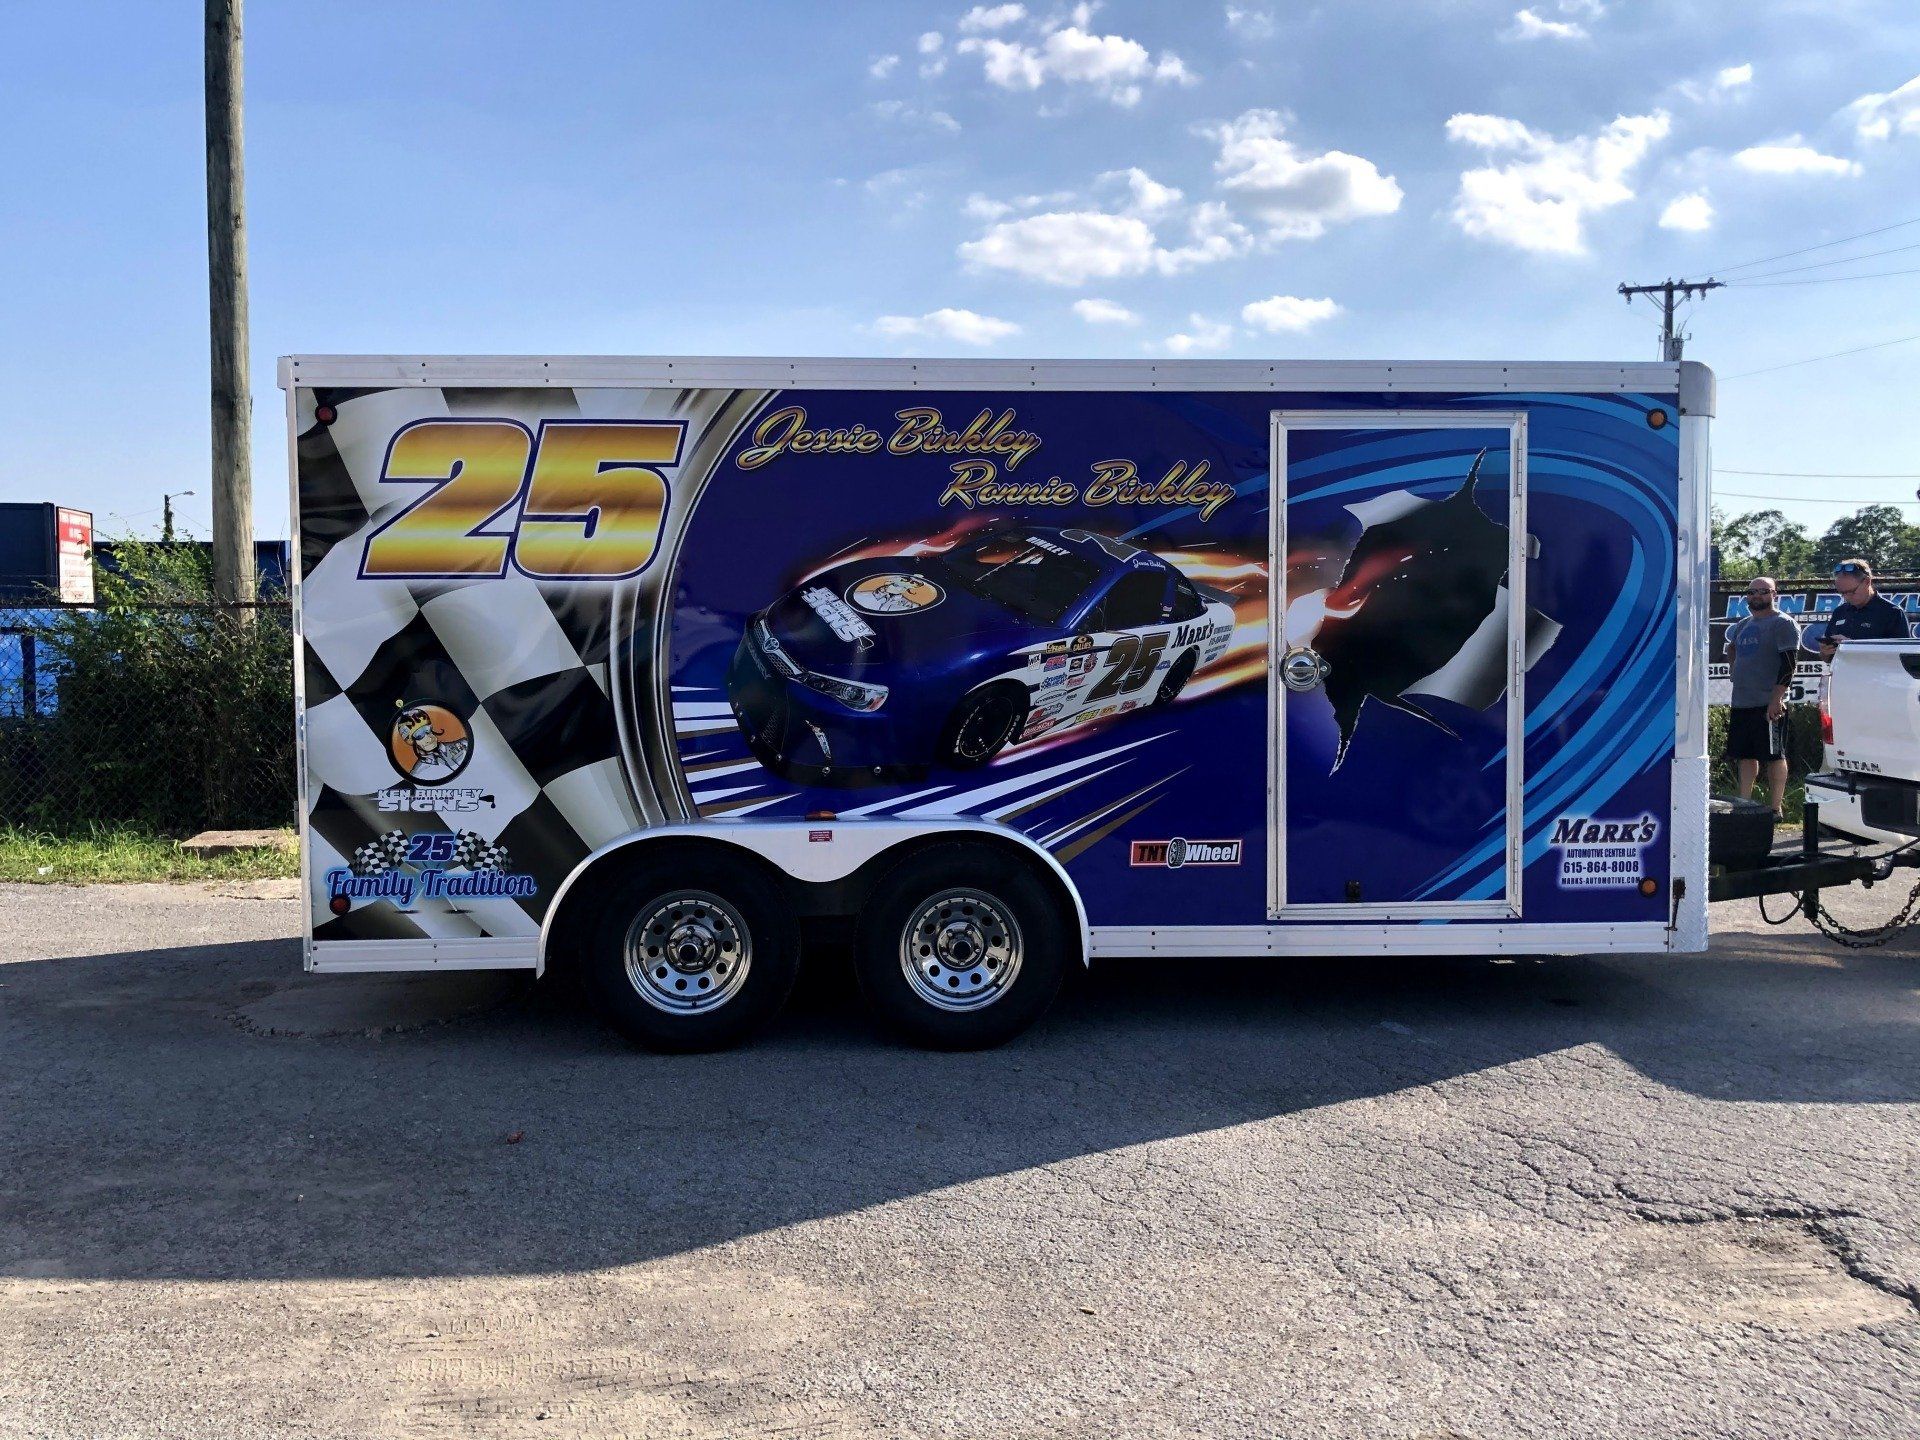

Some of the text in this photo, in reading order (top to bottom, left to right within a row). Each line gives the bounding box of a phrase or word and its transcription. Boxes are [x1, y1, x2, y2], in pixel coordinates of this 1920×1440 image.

[736, 406, 1042, 472] Jessie Binkley
[357, 417, 690, 581] 25
[938, 459, 1234, 523] Ronnie Binkley
[1082, 631, 1171, 706] 25
[1836, 759, 1881, 773] TITAN
[377, 788, 484, 800] KEN BINKLEY
[378, 799, 480, 812] SIGNS
[408, 834, 456, 862] 25
[1138, 844, 1238, 861] TNT Wheel
[1566, 848, 1604, 858] AUTOMOTIVE
[1604, 848, 1626, 858] CENTER
[1563, 860, 1639, 873] 615-864-8008
[327, 868, 537, 905] Family Tradition
[1561, 876, 1640, 885] MARKS-AUTOMOTIVE.COM
